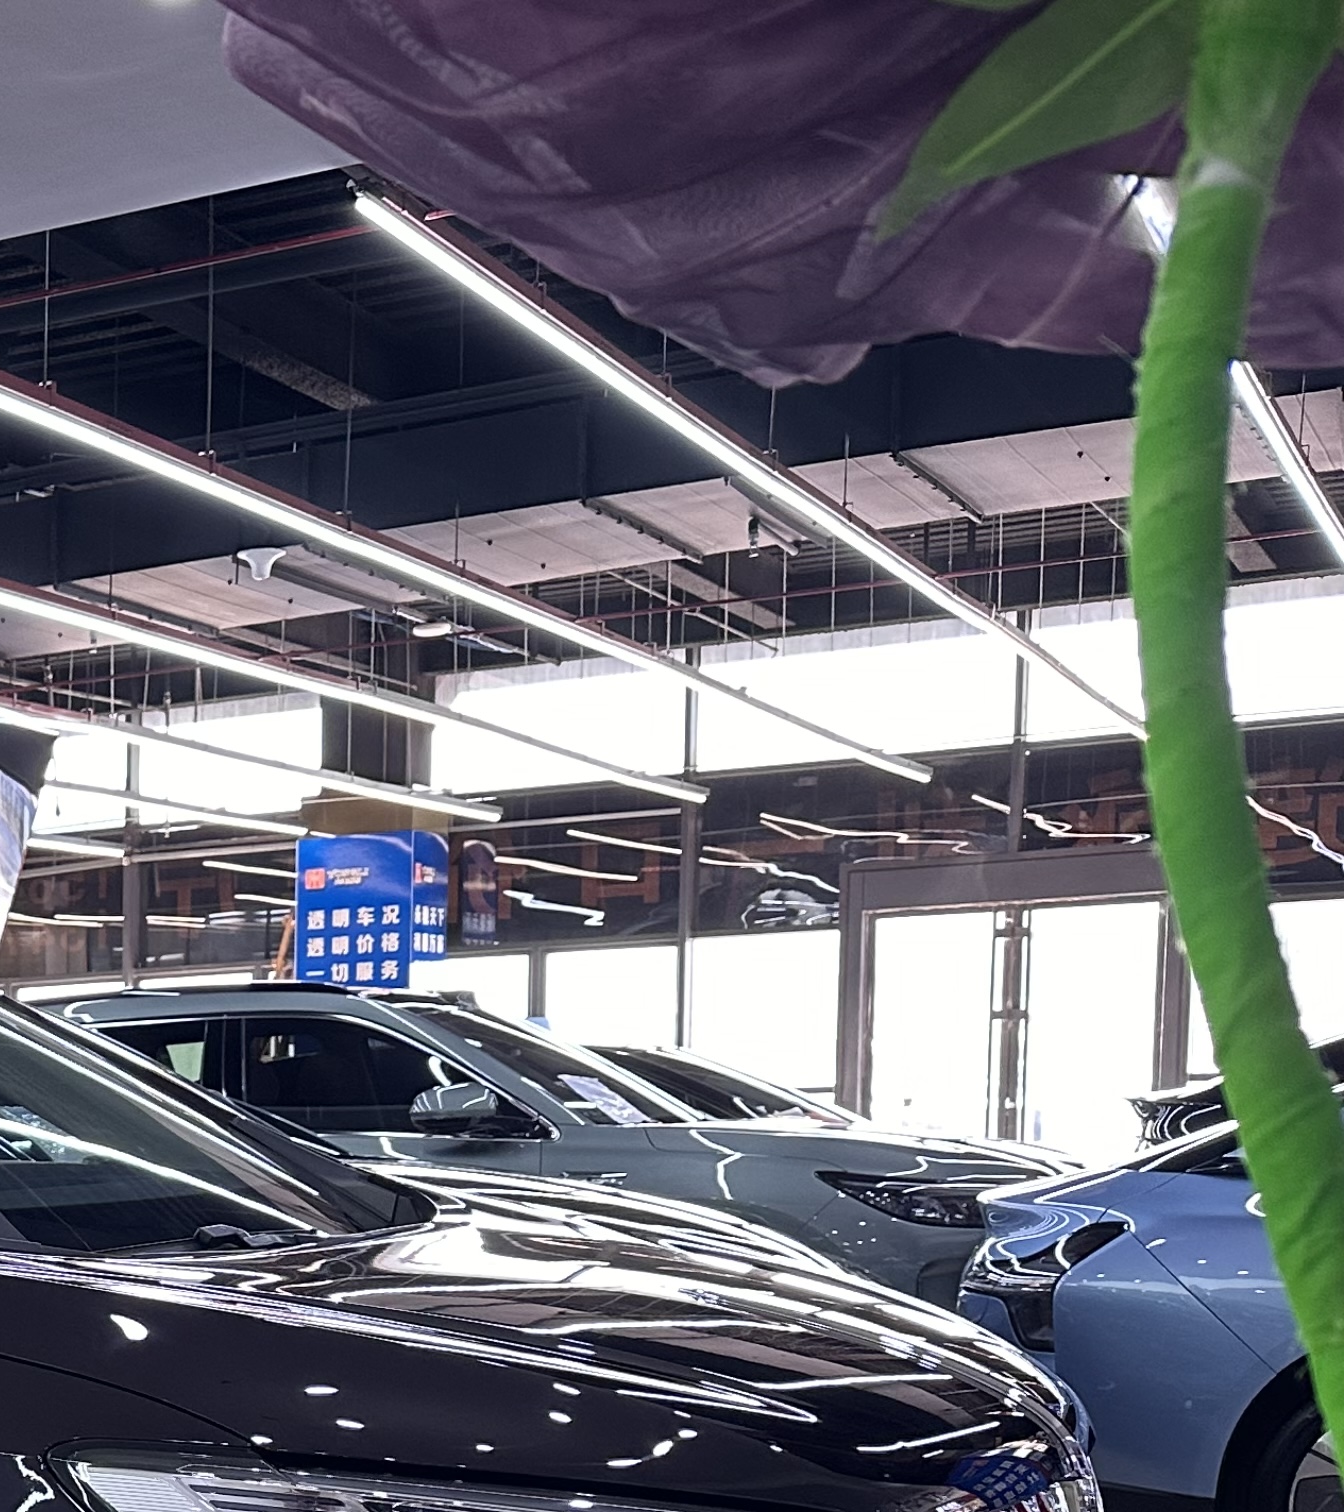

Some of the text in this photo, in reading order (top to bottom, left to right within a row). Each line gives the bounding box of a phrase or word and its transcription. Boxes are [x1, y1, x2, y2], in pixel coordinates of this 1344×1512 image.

[307, 905, 400, 930] 透明车况
[307, 932, 400, 957] 透明价格
[306, 960, 400, 983] 一切服务
